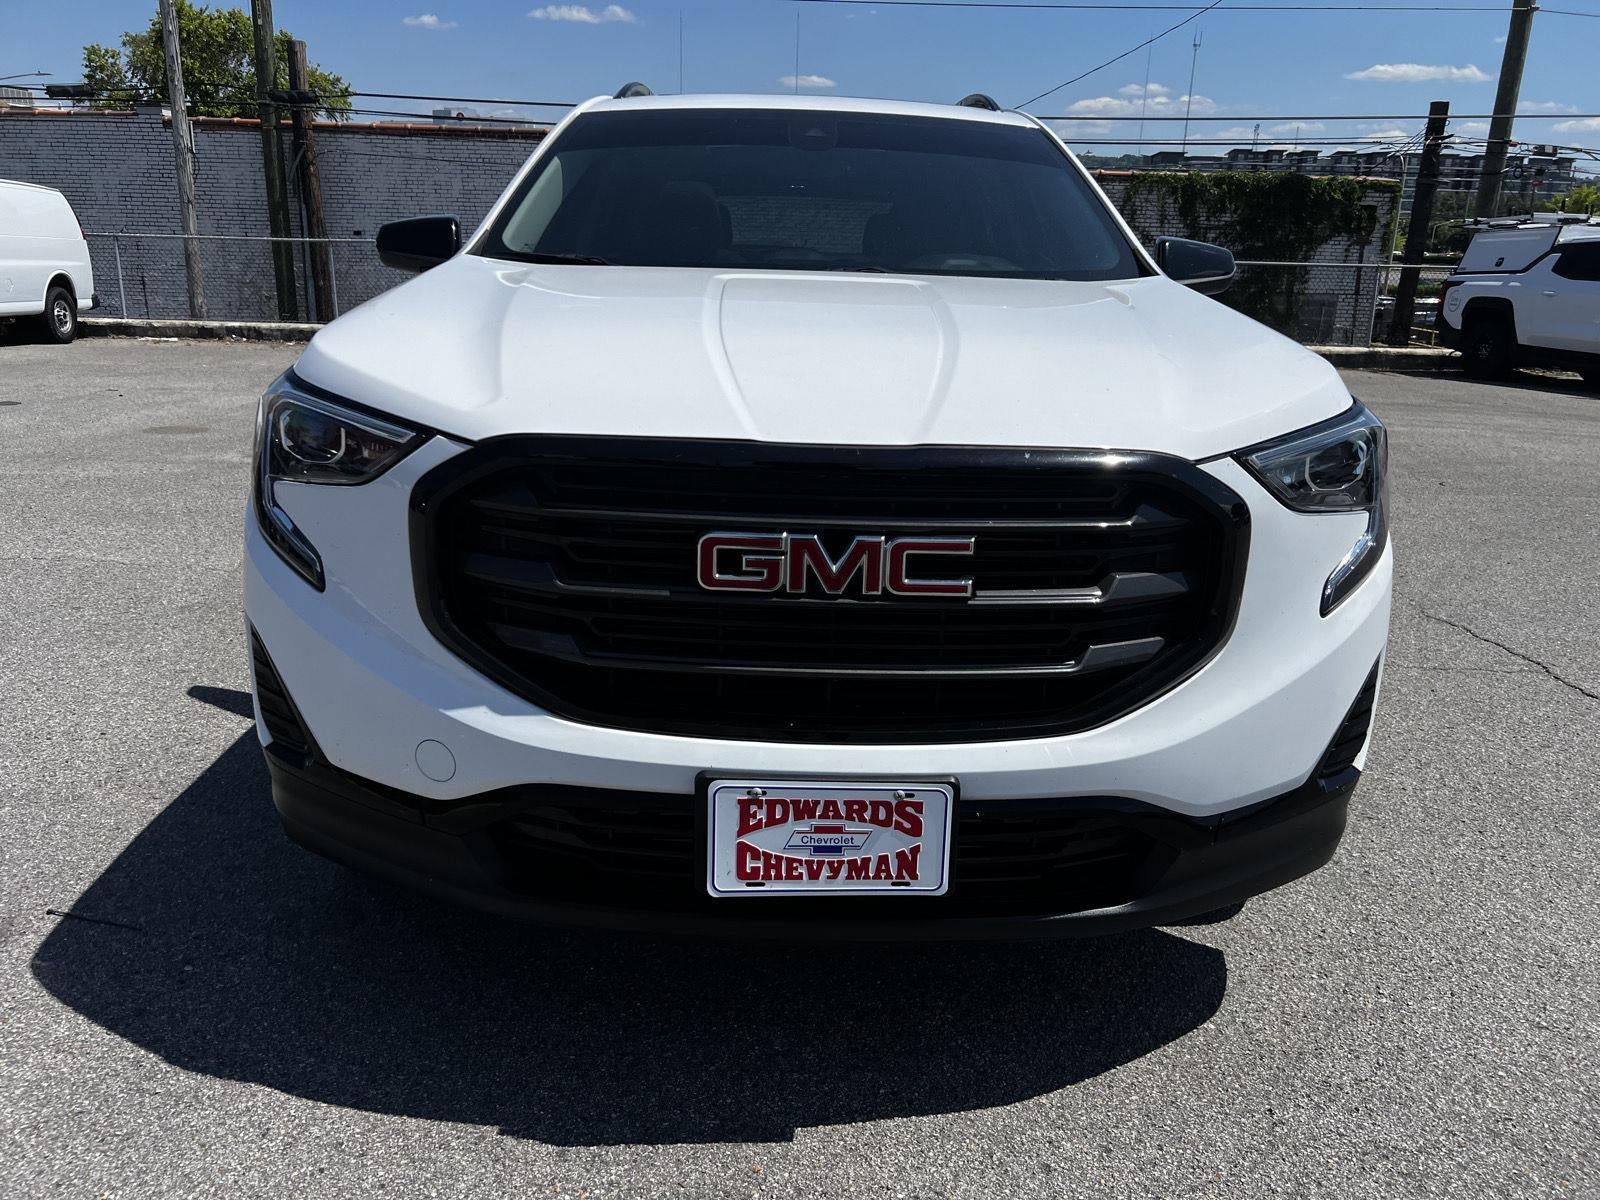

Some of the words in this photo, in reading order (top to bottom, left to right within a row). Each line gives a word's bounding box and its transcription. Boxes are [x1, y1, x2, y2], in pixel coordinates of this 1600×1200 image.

[697, 531, 975, 597] GMC
[737, 798, 924, 838] EDWARDS
[801, 834, 855, 845] Chevrolet
[736, 840, 922, 881] CHEVYMAN
